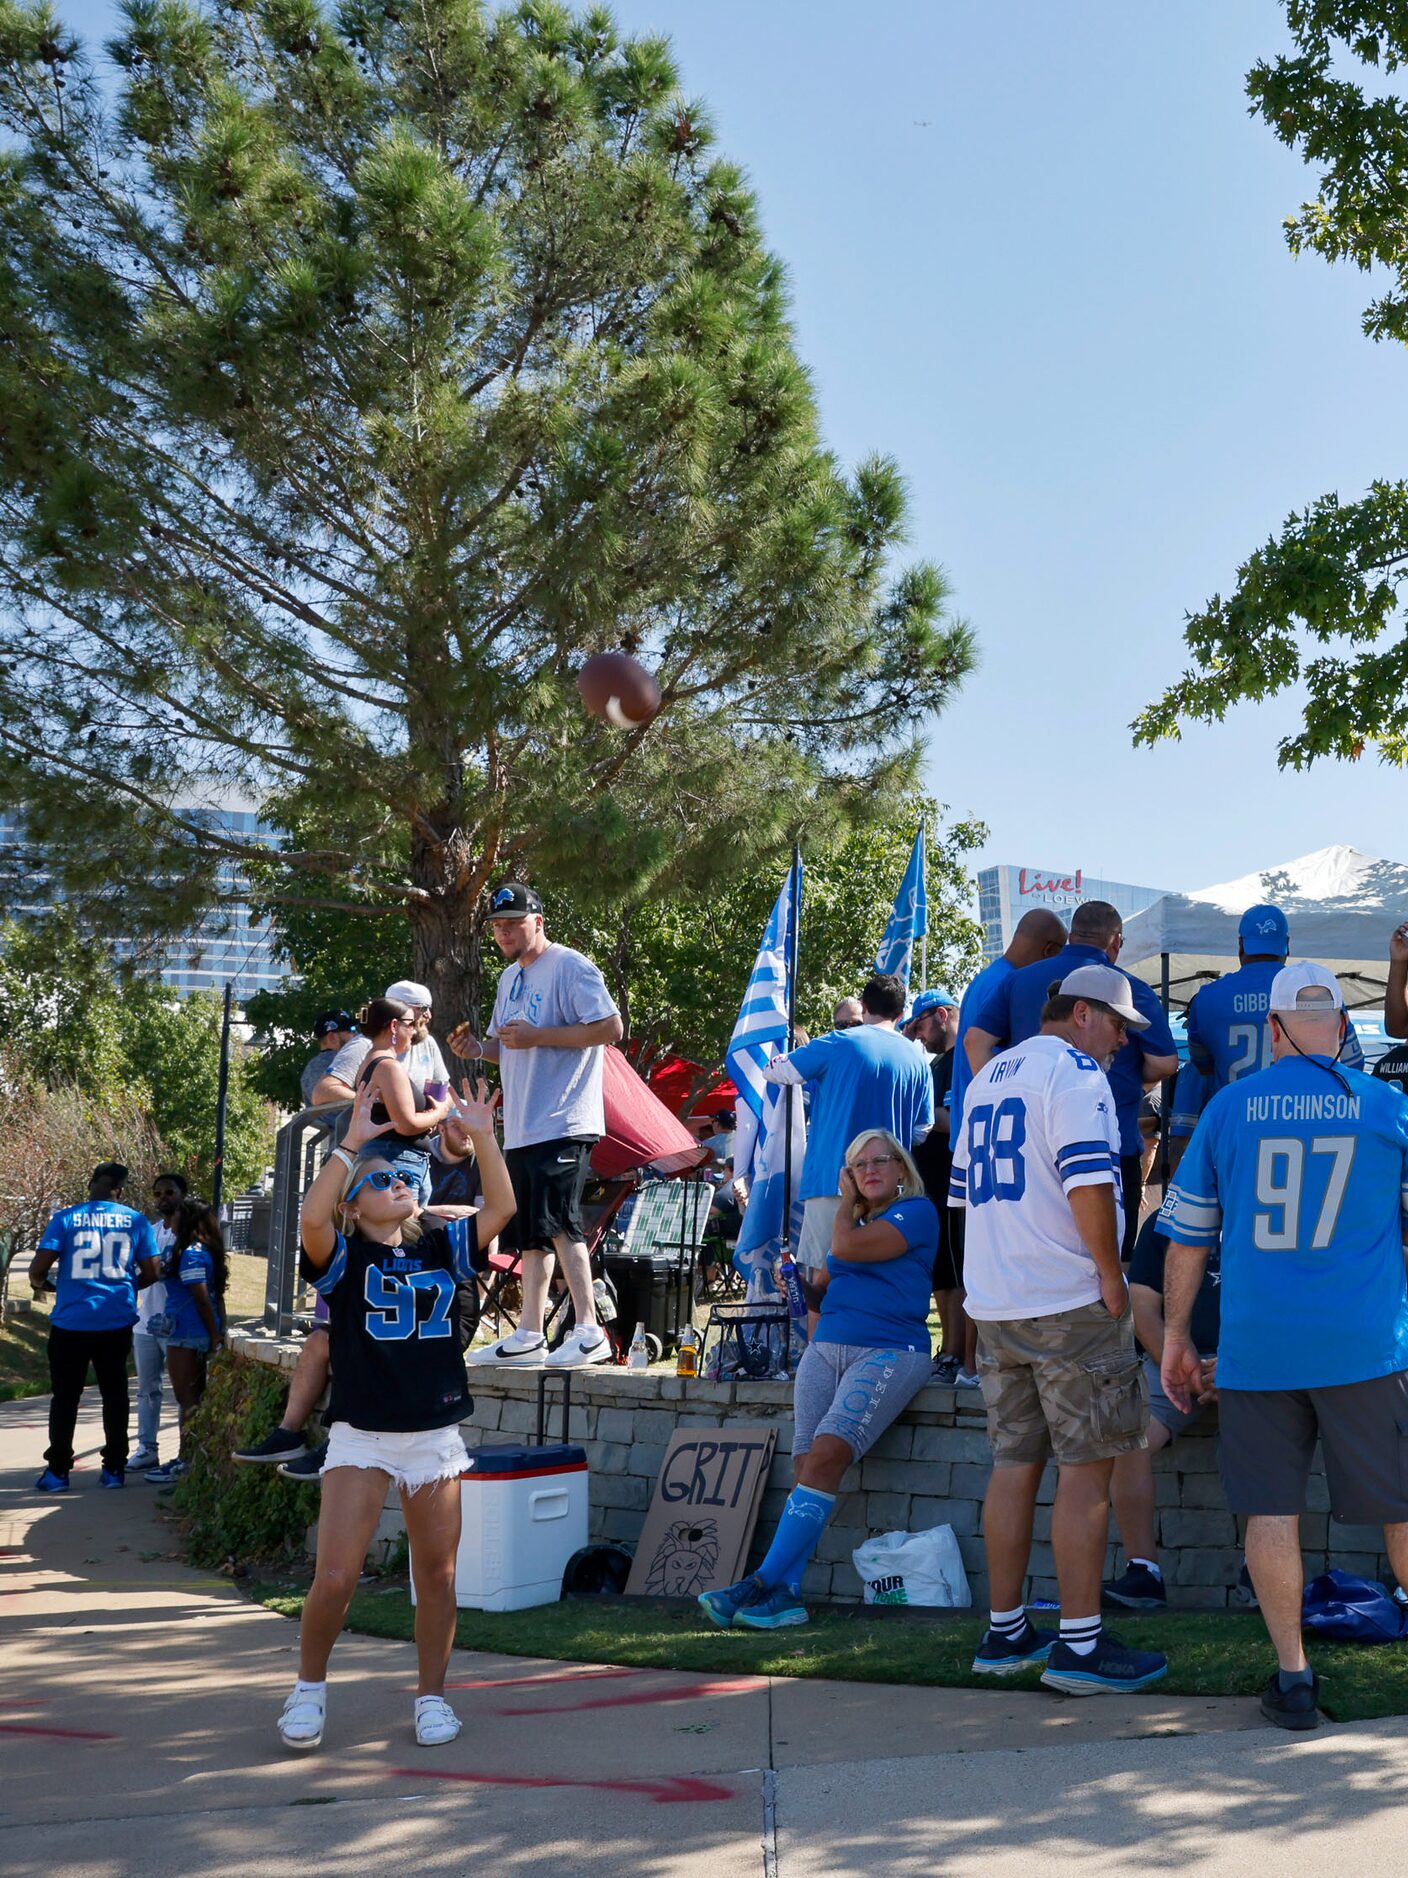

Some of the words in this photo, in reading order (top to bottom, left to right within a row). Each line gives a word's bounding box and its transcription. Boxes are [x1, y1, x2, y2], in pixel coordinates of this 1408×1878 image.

[1019, 868, 1081, 895] Live!
[1043, 893, 1098, 905] LOEW
[1233, 992, 1272, 1013] GIBB
[989, 1056, 1027, 1083] IRVIN
[1246, 1094, 1361, 1122] HUTCHINSON
[967, 1097, 1027, 1208] 88
[1253, 1134, 1357, 1250] 97
[73, 1213, 132, 1228] SANDERS
[71, 1230, 131, 1279] 20
[383, 1258, 422, 1272] LIONS
[364, 1263, 456, 1341] 97
[661, 1442, 764, 1508] GRIT
